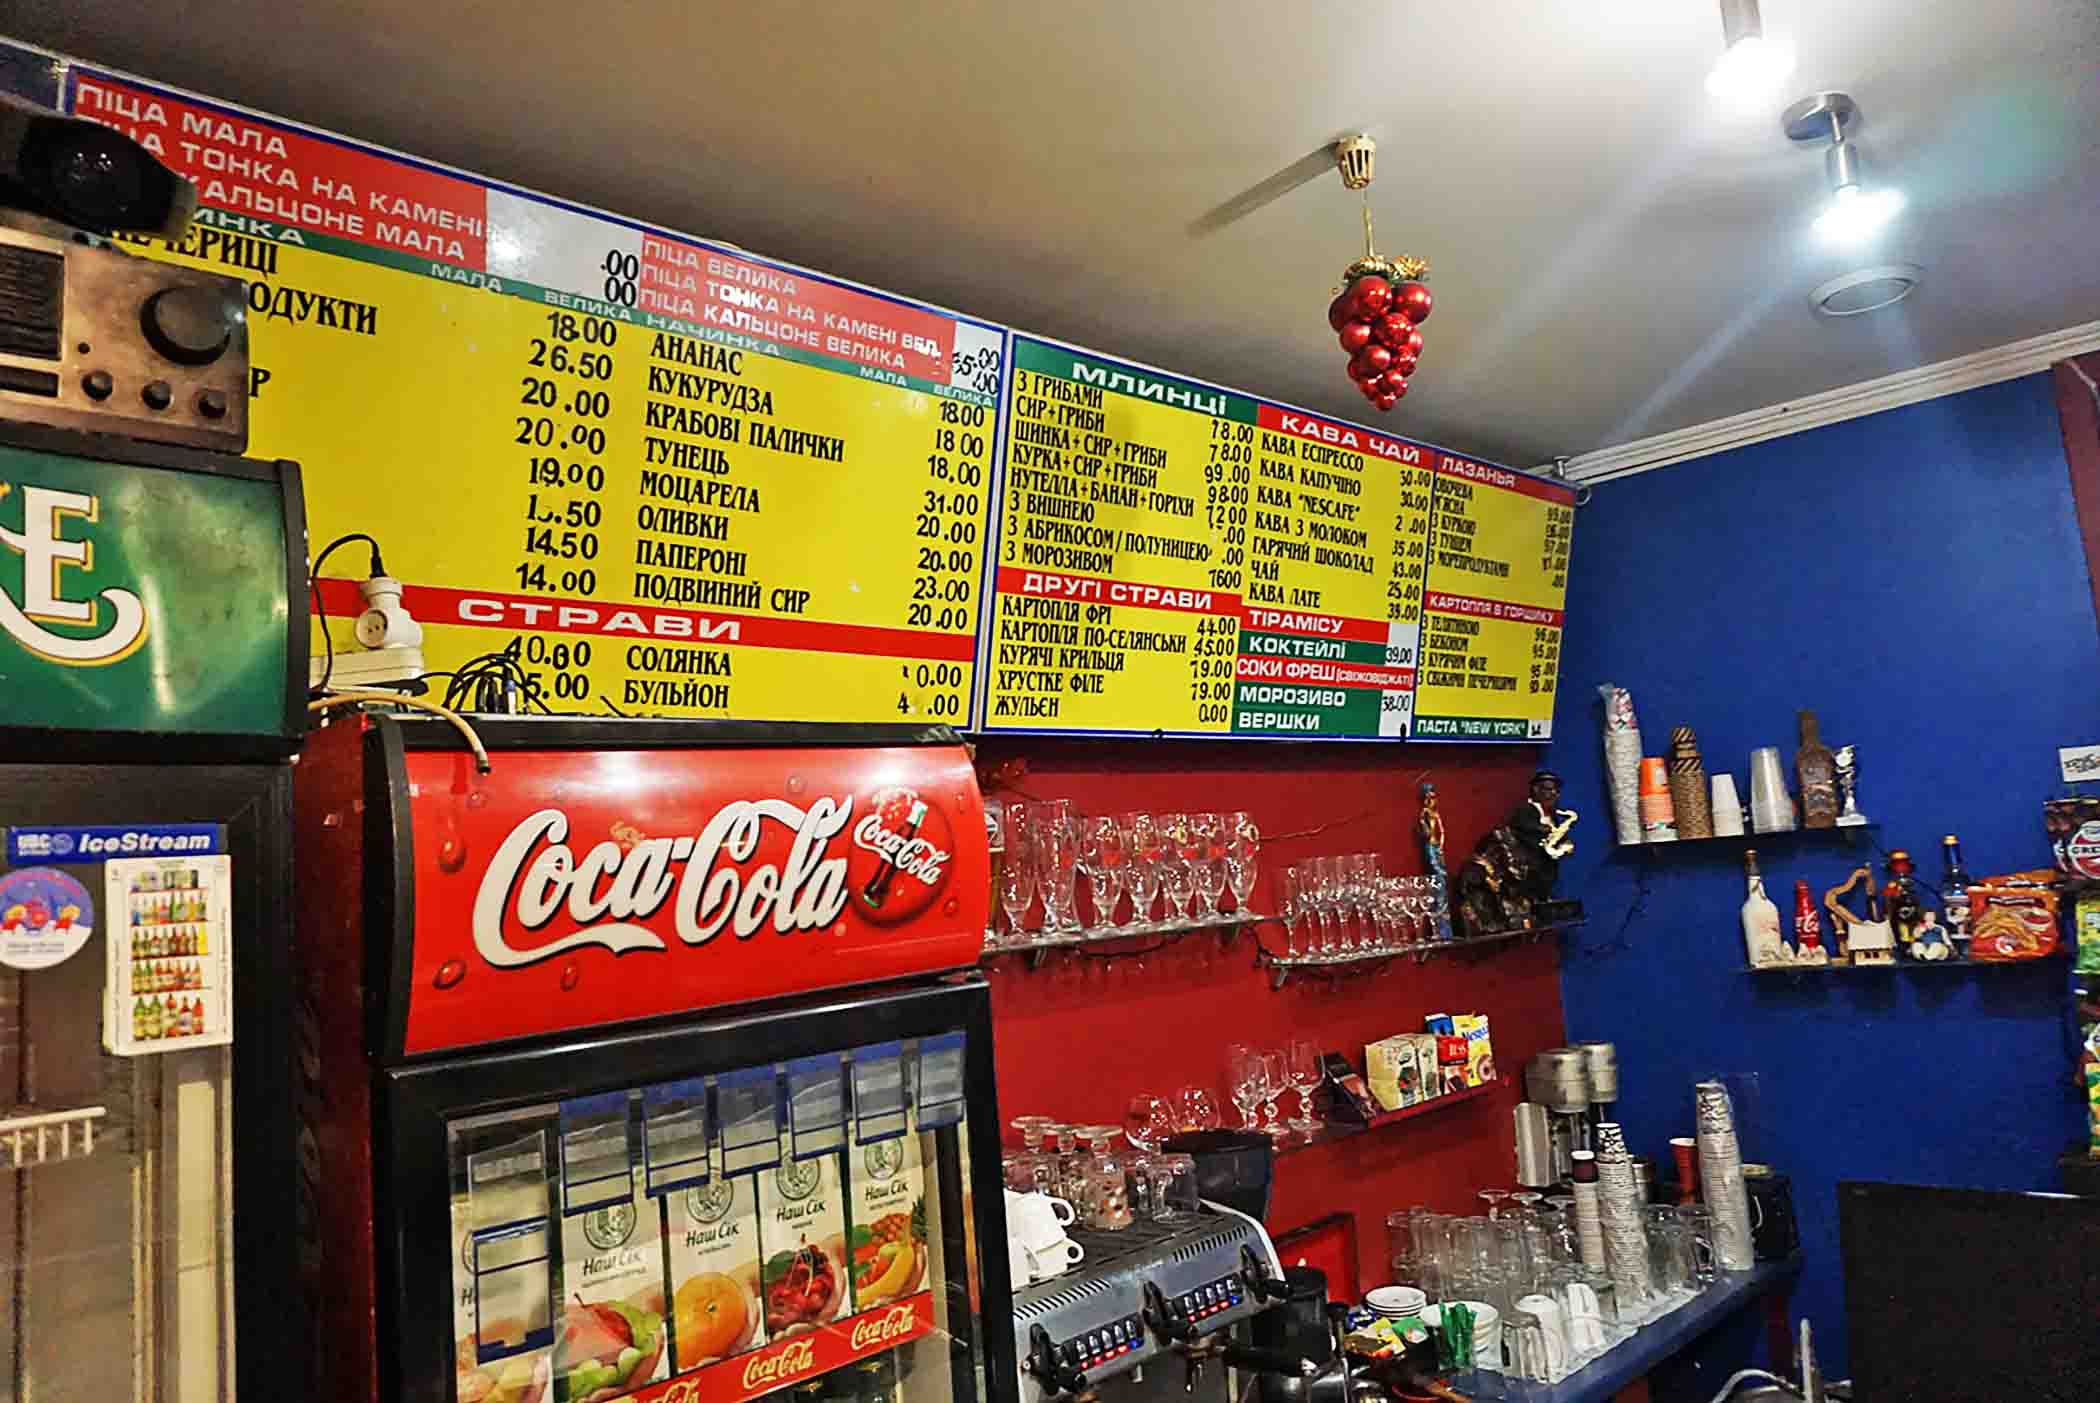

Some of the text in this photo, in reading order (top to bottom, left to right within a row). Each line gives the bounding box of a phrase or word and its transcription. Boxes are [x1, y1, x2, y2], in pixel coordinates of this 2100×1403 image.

[77, 82, 167, 127] ПІЦА
[182, 111, 287, 158] МАЛА
[179, 141, 483, 239] ТОНКА НА КАМЕНІ
[203, 180, 465, 261] АЛЬЦОНЕ МАЛА
[643, 240, 798, 295] ПІЦА ВЕЛИКА
[431, 262, 503, 293] МАЛА
[544, 289, 633, 322] ВЕЛИКА
[640, 262, 697, 293] ПІЦА
[706, 280, 779, 313] ТОНКА
[786, 304, 817, 323] НА
[824, 312, 897, 344] КАМЕНІ
[640, 286, 906, 369] ПІЦА КАЛЬЦОНЕ ВЕЛИКА
[528, 339, 613, 381] 26.50
[646, 313, 781, 356] НАЧИНКА
[860, 365, 909, 388] МАЛА
[651, 333, 744, 376] АНАНАС
[648, 365, 774, 417] КУКУРУДЗА
[1033, 375, 1104, 410] ГРИБАМИ
[1072, 362, 1228, 416] МЛИНЦІ
[645, 401, 981, 487] КРАБОВІ ПАЛИЧКИ 18.00
[1261, 432, 1297, 458] КАВА
[1301, 441, 1365, 474] ЕСПРЕССО
[1281, 414, 1421, 465] КАВА ЧАЙ
[529, 457, 605, 493] 19.00
[643, 435, 978, 517] ТУНЕЦЬ 31.00
[1259, 458, 1295, 483] КАВА
[1441, 456, 1517, 489] ЛАЗАНЬЯ
[639, 469, 976, 545] МОЦАРЕЛА 20.00
[1026, 493, 1095, 522] ВИШНЕЮ
[1257, 485, 1292, 510] КАВА
[526, 527, 599, 561] 14.50
[637, 504, 973, 573] ОЛИВКИ 20.00
[1023, 517, 1114, 551] АБРИКОСОМ
[1124, 532, 1209, 564] ПОЛУНИЦЕЮ
[1255, 510, 1290, 535] КАВА
[1308, 520, 1368, 550] МОЛОКОМ
[635, 539, 970, 603] ПАПЕРОНІ 23.00
[1021, 543, 1114, 575] МОРОЗИВОМ
[1250, 558, 1280, 582] ЧАЙ
[1252, 535, 1311, 563] ГАРЯЧИЙ
[1315, 546, 1375, 576] ШОКОЛАД
[516, 565, 597, 597] 14.00
[1023, 572, 1212, 611] ДРУГІ СТРАВИ
[1248, 582, 1285, 602] КАВА
[1291, 588, 1321, 610] ЛАТЕ
[458, 598, 741, 642] СТРАВИ
[771, 589, 811, 615] СИР
[907, 603, 968, 630] 20.00
[1002, 595, 1080, 623] КАРТОПЛЯ
[1086, 604, 1113, 626] ФРІ
[1249, 609, 1345, 634] ТІРАМІСУ
[1000, 619, 1079, 647] КАРТОПЛЯ
[1249, 635, 1347, 660] КОКТЕЙЛІ
[626, 645, 732, 678] СОЛЯНКА
[999, 643, 1054, 667] КУРЯЧІ
[1059, 646, 1126, 673] КРИЛЬЦЯ
[1236, 658, 1283, 678] СОКИ
[1285, 664, 1336, 683] ФРЕШ
[623, 679, 730, 710] БУЛЬЙОН
[996, 669, 1064, 693] ХРУСТКЕ
[1070, 672, 1105, 695] ФІЛЕ
[1239, 685, 1347, 708] МОРОЗИВО
[993, 695, 1060, 718] ЖУЛЬЄН
[1238, 711, 1321, 731] ВЕРШКИ
[1416, 719, 1458, 735] ПАСТА
[78, 832, 211, 854] IceStream
[853, 814, 951, 886] Coca-Cola
[473, 795, 855, 968] Coca-Cola
[864, 1184, 890, 1202] Наш
[776, 1204, 804, 1223] Наш
[686, 1226, 716, 1248] Наш
